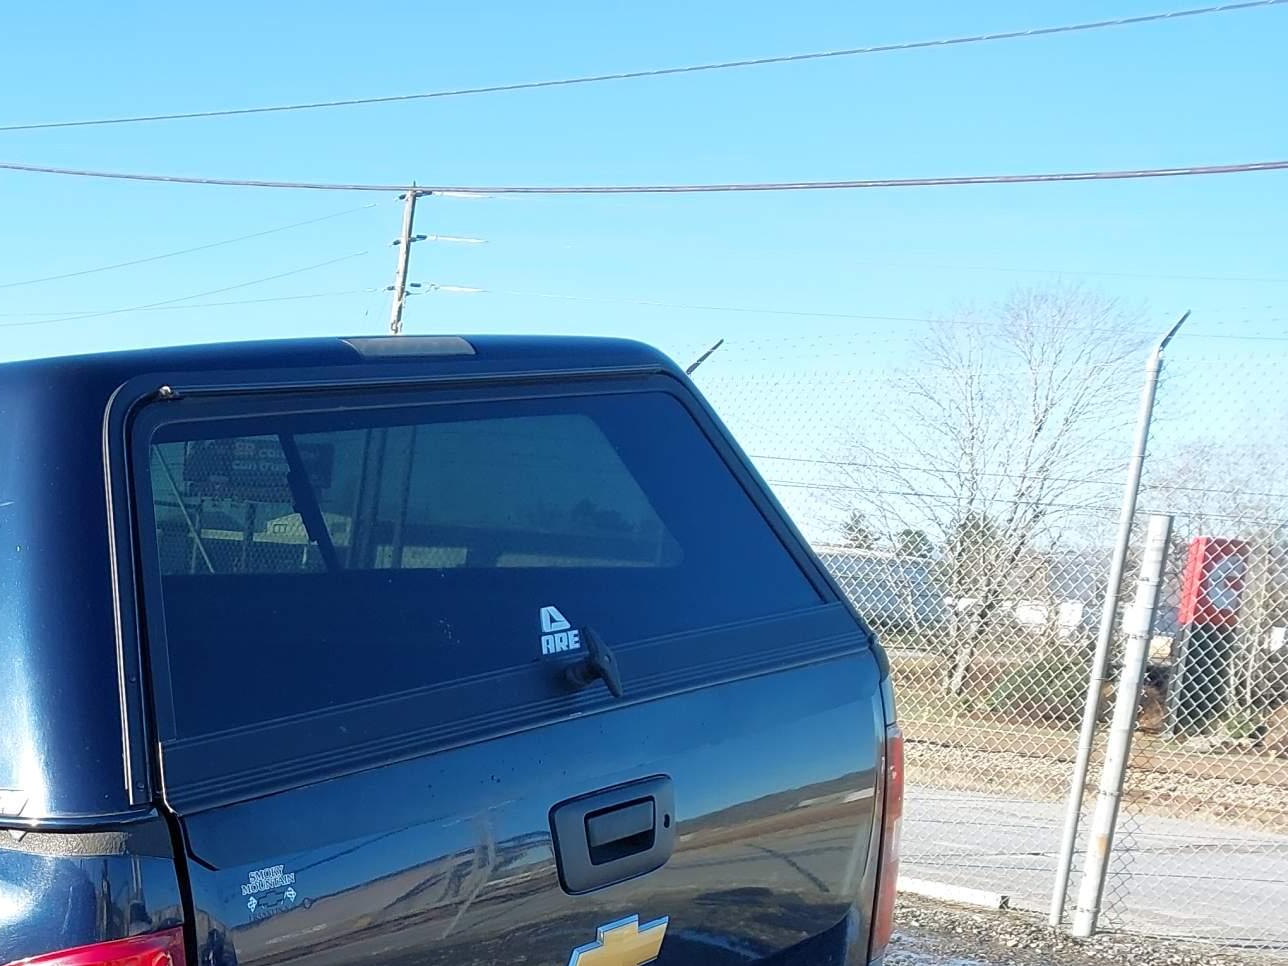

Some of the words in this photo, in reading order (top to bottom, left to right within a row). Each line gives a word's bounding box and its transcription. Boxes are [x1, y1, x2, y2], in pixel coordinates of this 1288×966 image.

[541, 629, 581, 655] ARE
[240, 872, 296, 896] MOUNTAIN
[248, 864, 285, 883] SMOKY
